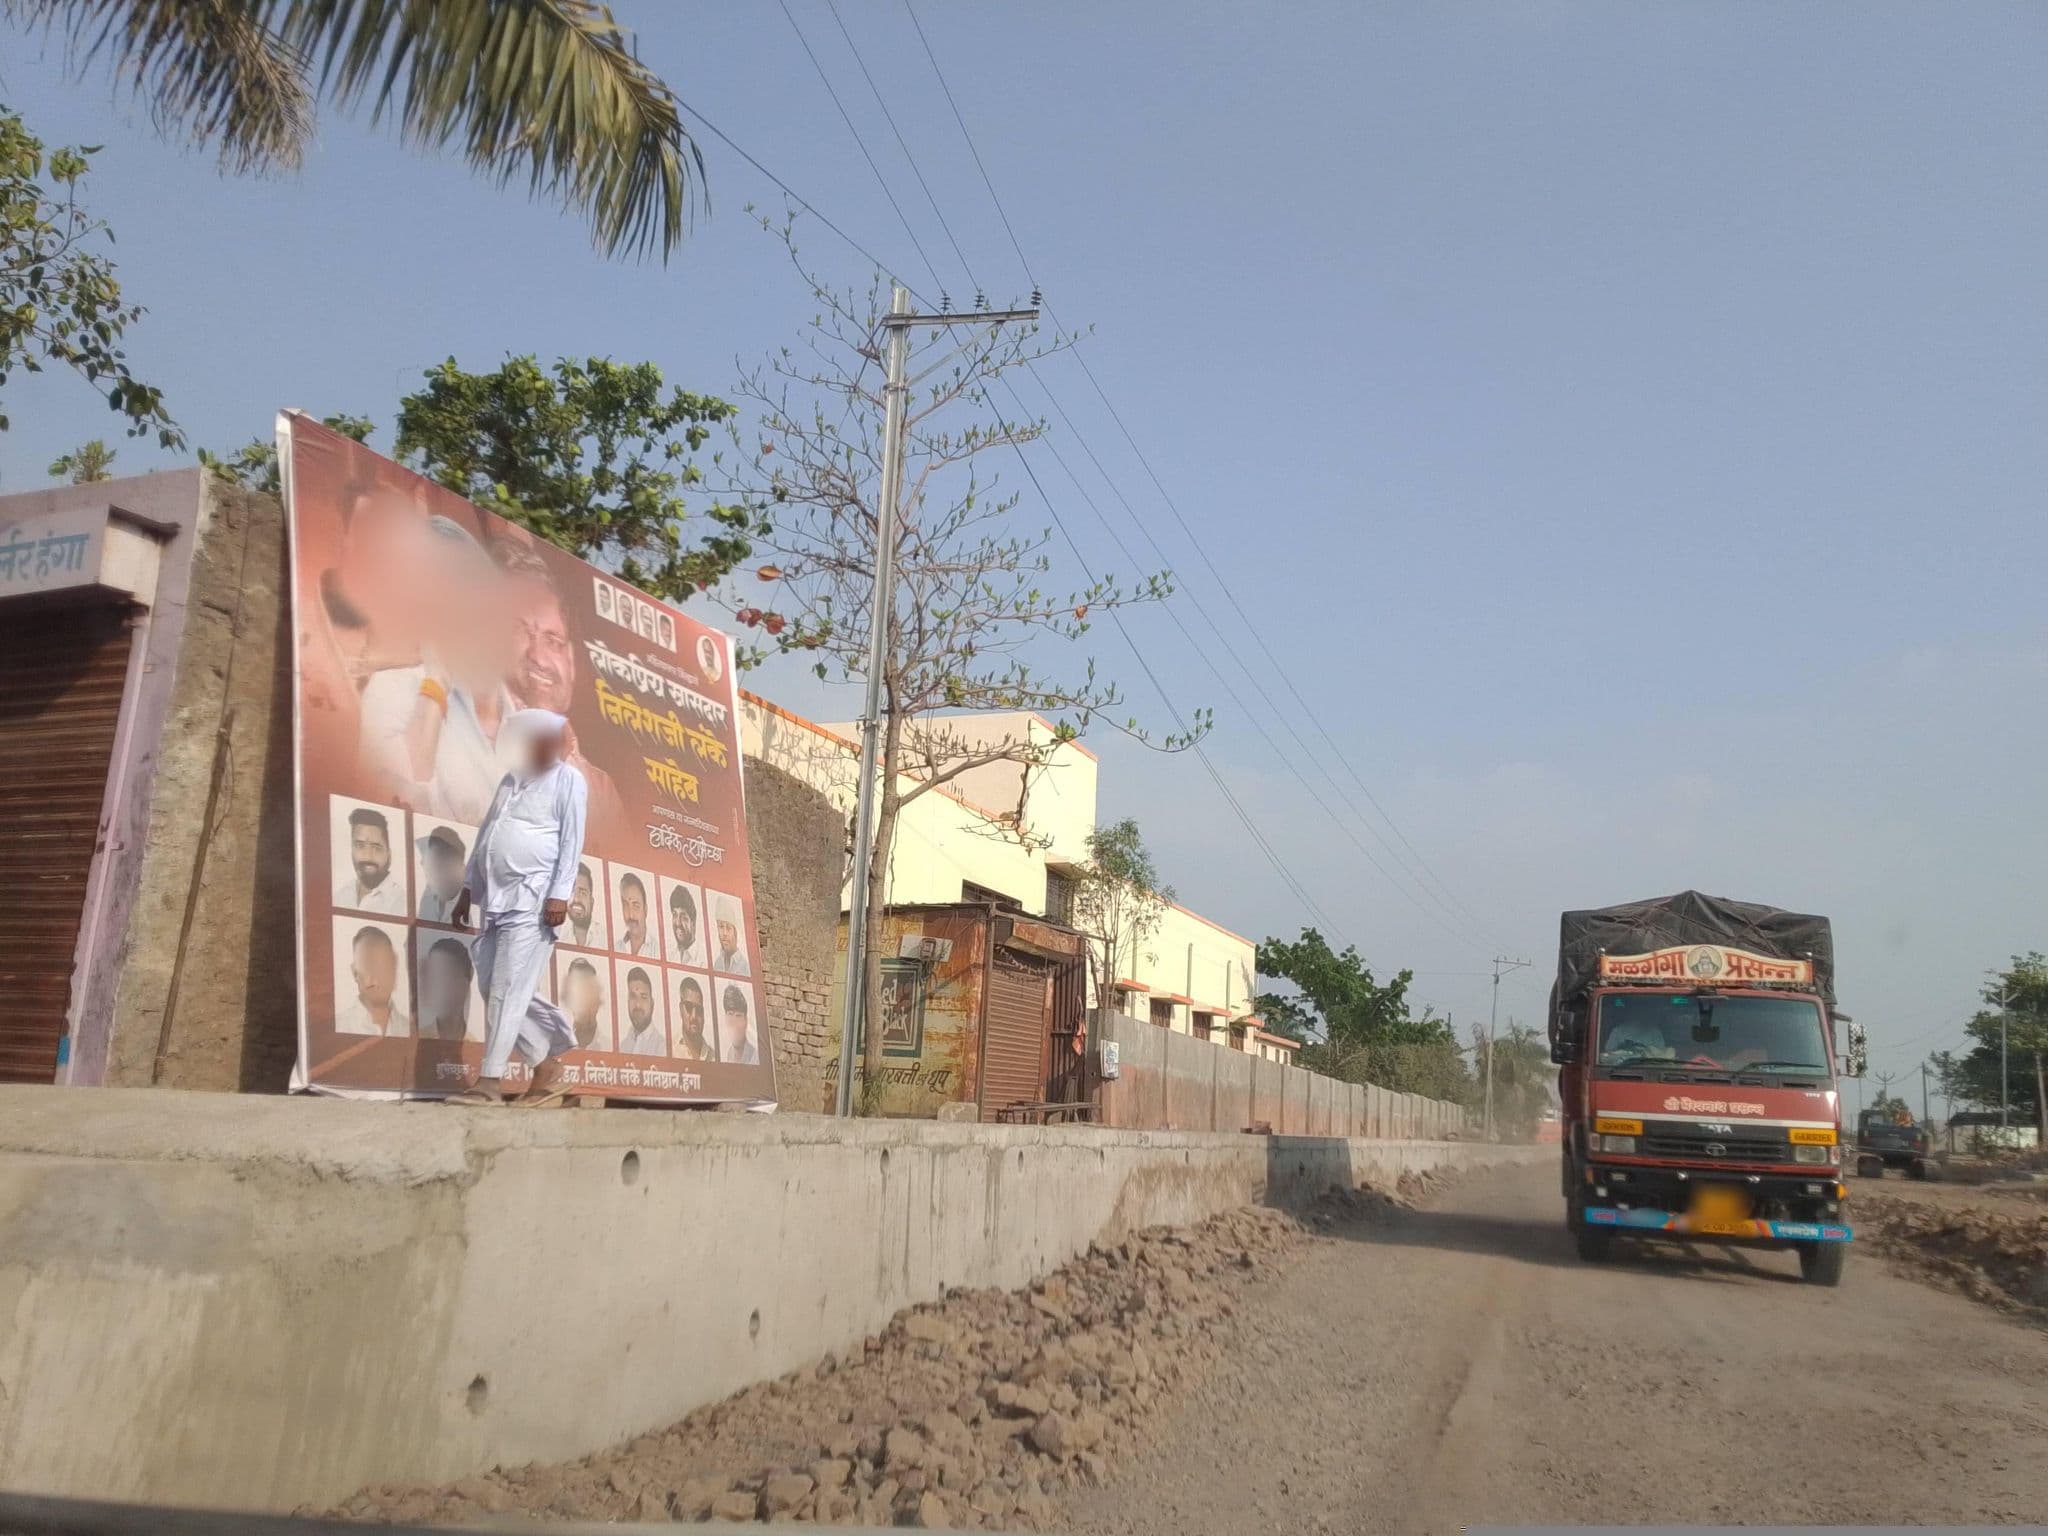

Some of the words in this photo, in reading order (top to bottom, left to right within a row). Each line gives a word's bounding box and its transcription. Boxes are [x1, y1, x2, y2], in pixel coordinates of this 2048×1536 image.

[583, 638, 665, 698] लोकप्रिय
[665, 678, 728, 731] खासदार
[595, 678, 685, 752] निलेशजी
[684, 723, 729, 772] लंके
[642, 757, 700, 813] साहेब
[1608, 951, 1686, 977] मळगंगा
[1725, 952, 1799, 979] प्रसन्न
[880, 1004, 909, 1041] Black
[584, 1060, 617, 1086] निलेश
[620, 1062, 641, 1087] लंके
[927, 1069, 952, 1095] धूप
